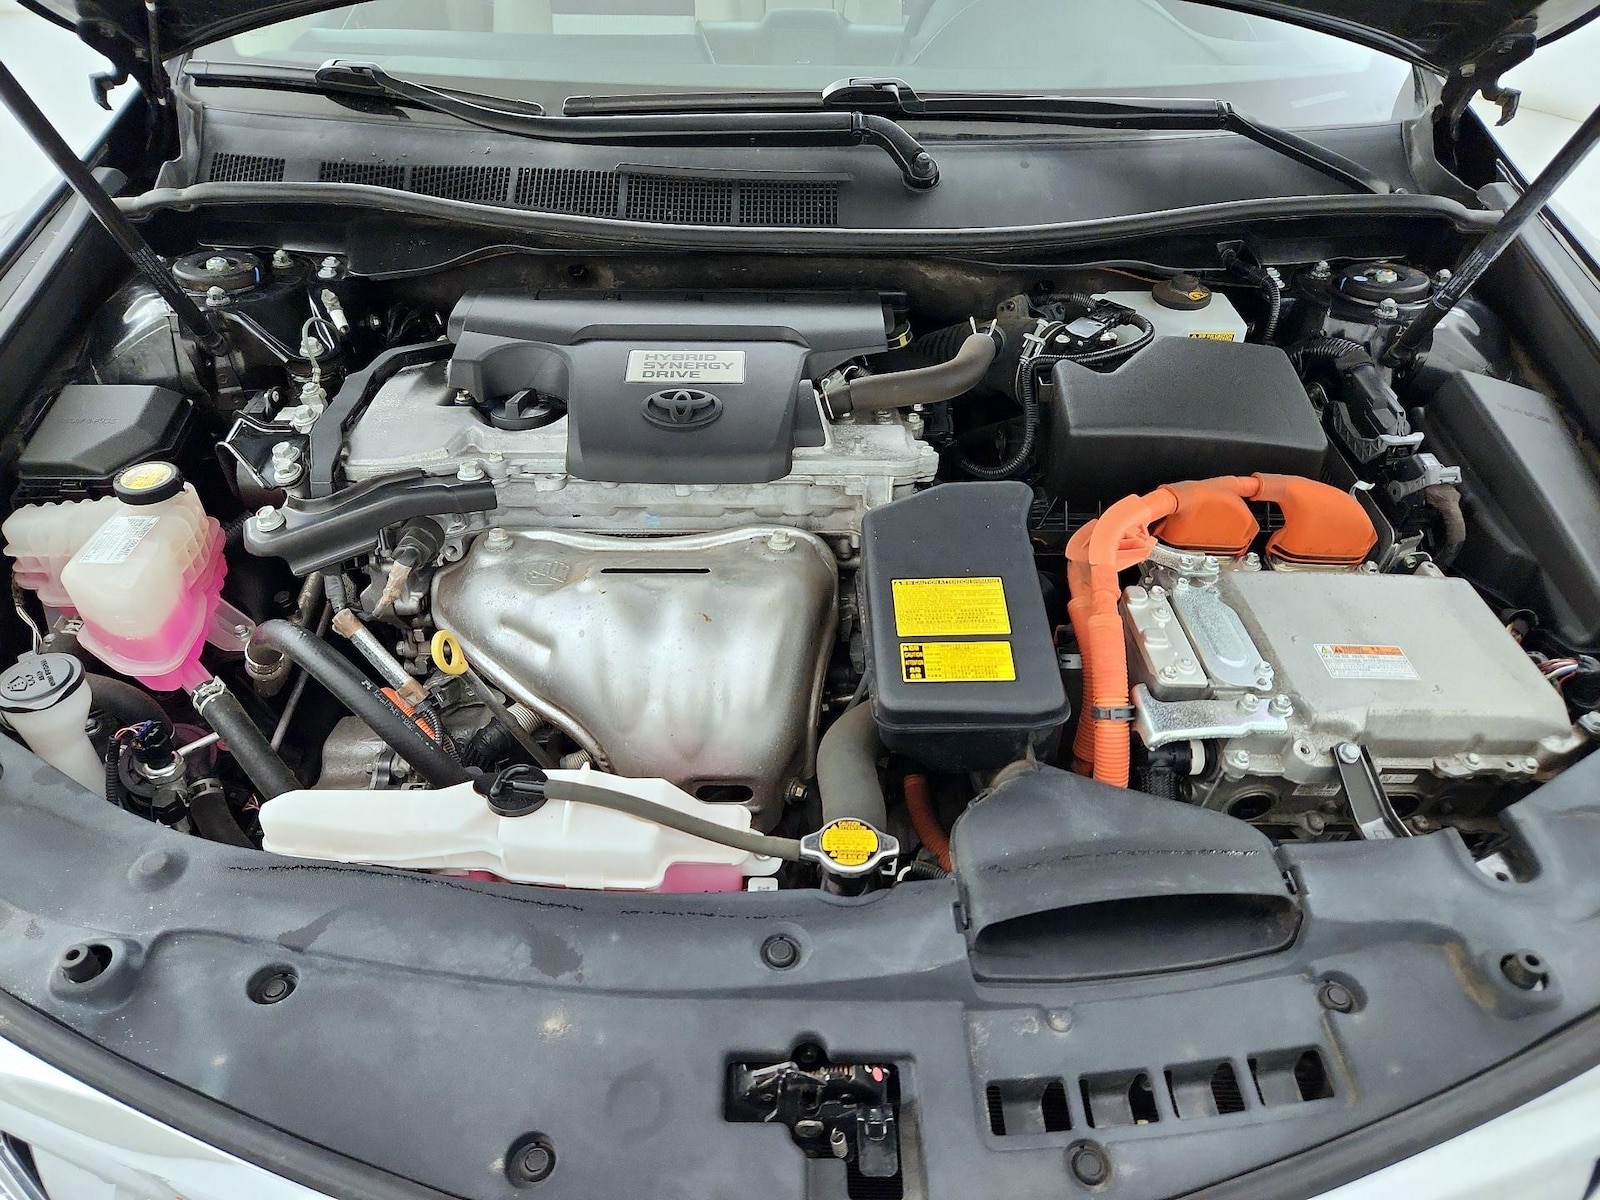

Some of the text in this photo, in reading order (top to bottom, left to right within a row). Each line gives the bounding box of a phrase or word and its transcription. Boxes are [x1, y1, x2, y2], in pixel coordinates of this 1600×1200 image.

[644, 353, 717, 361] HYBRID
[643, 361, 734, 369] SYNERGY
[642, 370, 701, 379] DRIVE
